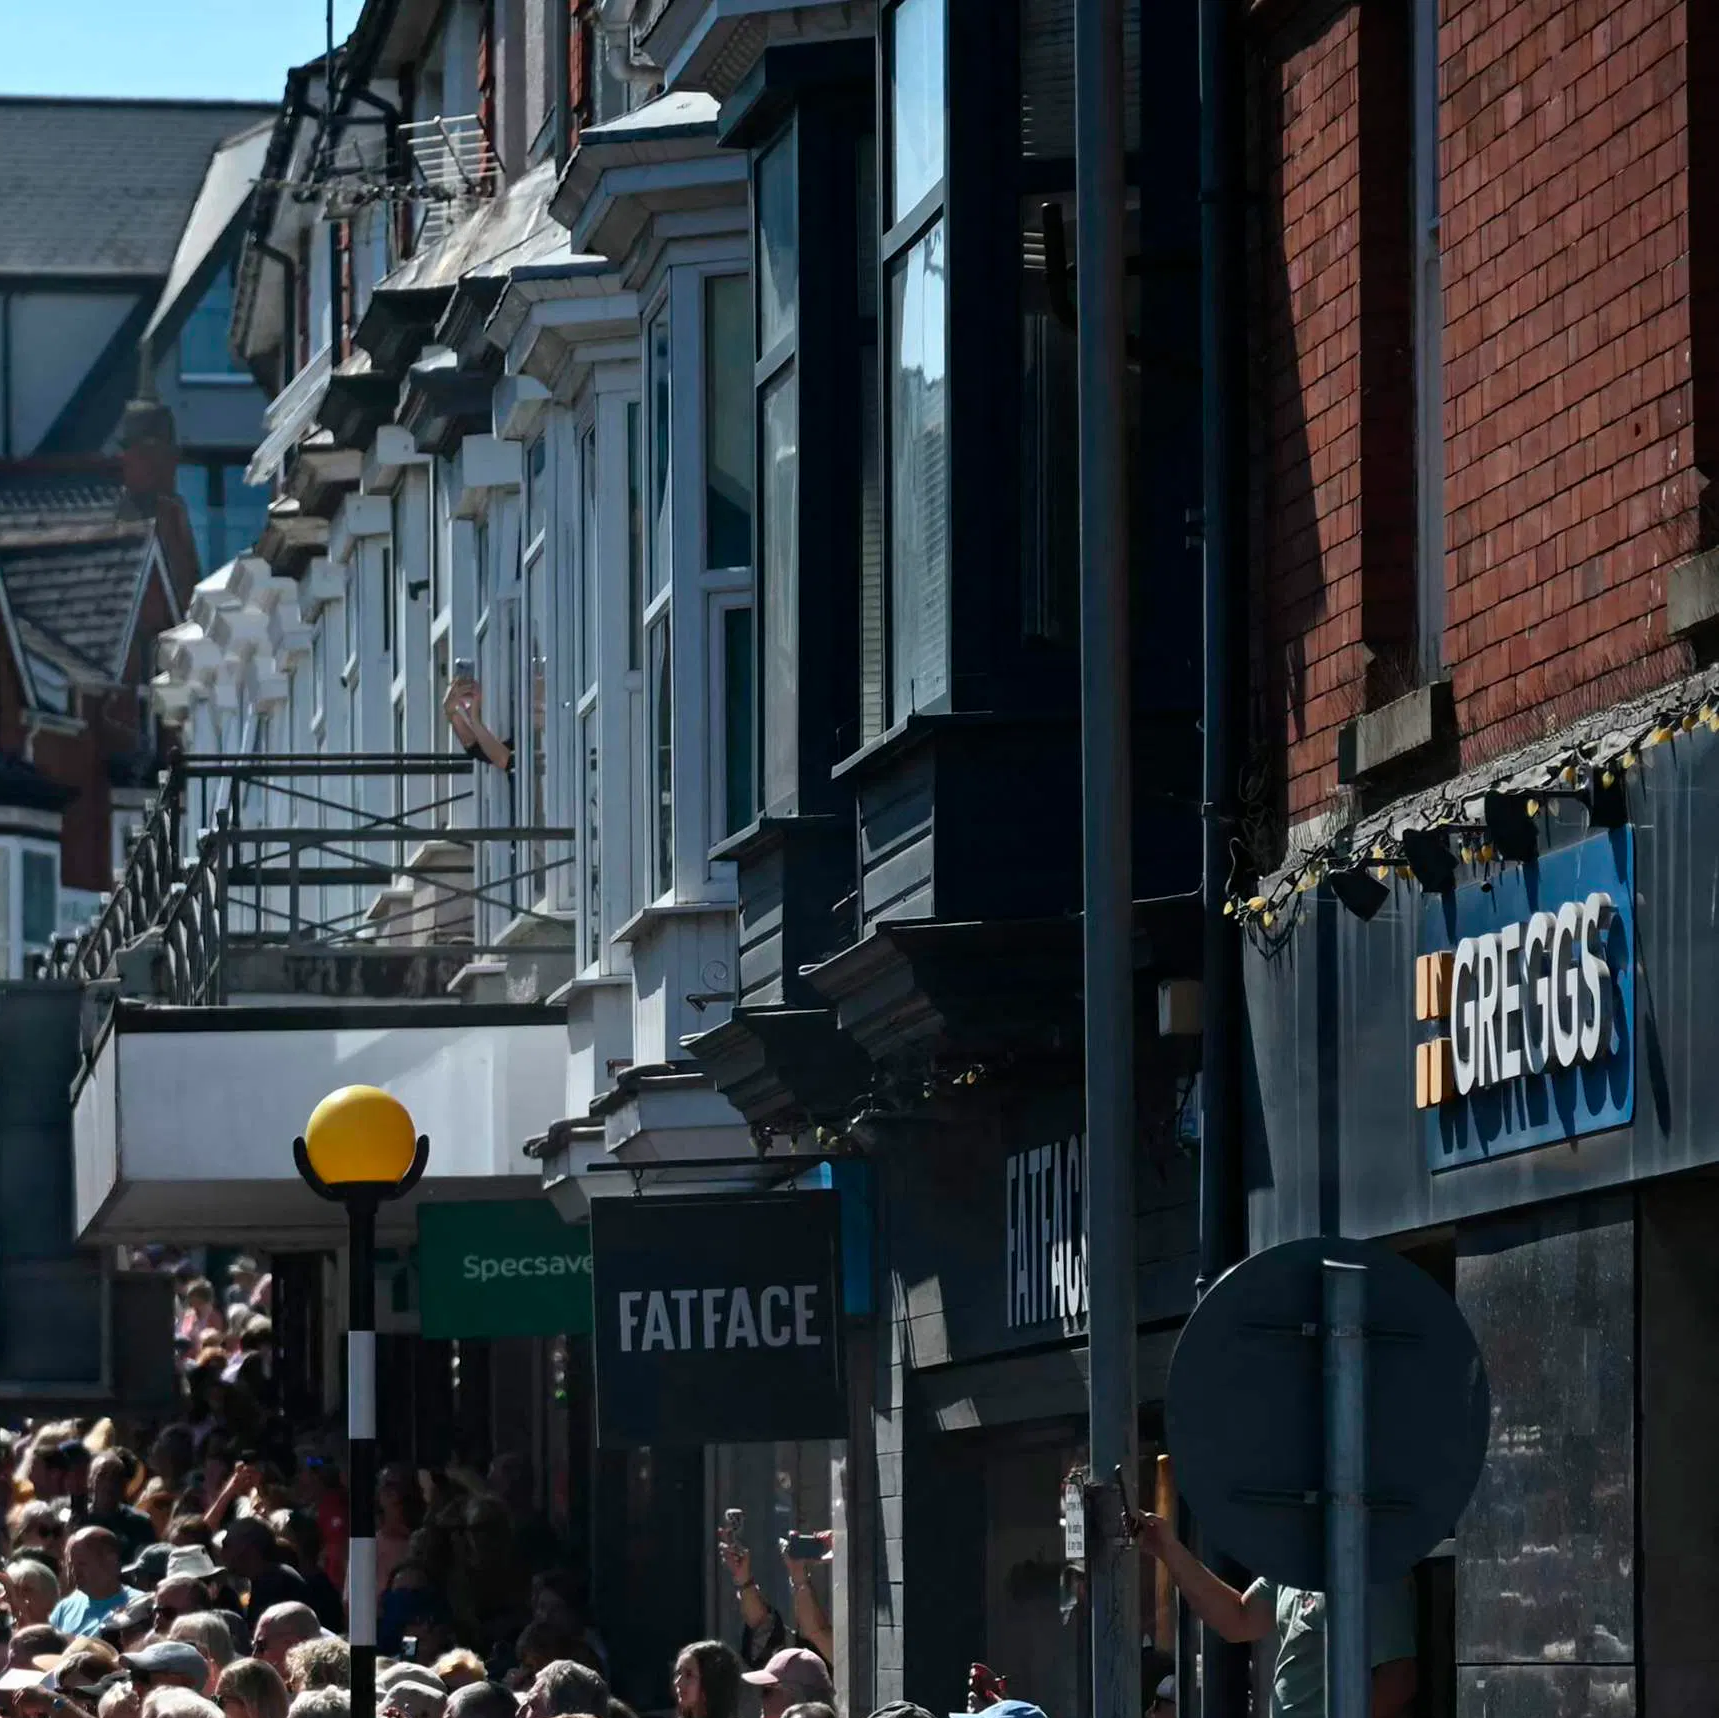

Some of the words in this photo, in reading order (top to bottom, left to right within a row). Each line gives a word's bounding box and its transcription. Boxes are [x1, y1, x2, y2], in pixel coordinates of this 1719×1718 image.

[1450, 892, 1611, 1096] GREGGS
[462, 1254, 593, 1282] Specsave
[618, 1284, 821, 1352] FATFACE
